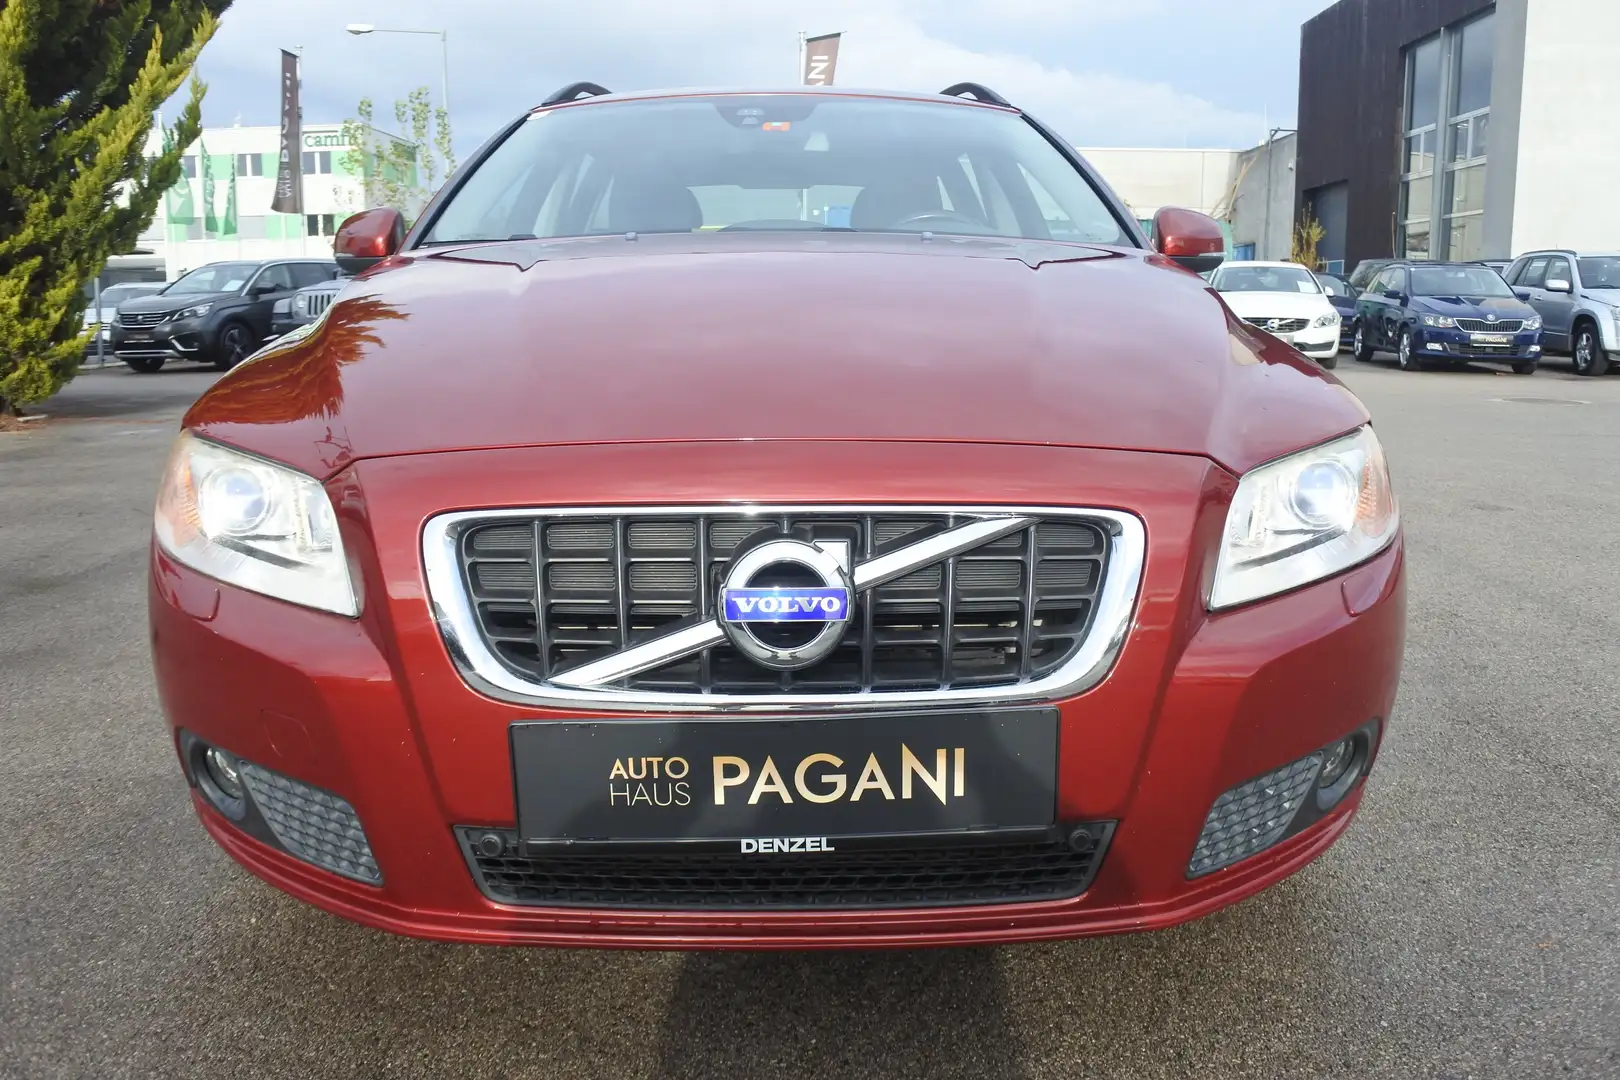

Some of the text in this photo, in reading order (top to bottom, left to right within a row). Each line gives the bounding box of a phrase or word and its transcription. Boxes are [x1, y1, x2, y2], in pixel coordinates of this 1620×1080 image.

[807, 55, 830, 85] NI
[731, 596, 841, 613] VOLVO
[609, 755, 690, 780] AUTO
[712, 742, 966, 806] PAGANI
[609, 781, 691, 807] HAUS
[740, 836, 835, 854] DENZEL
